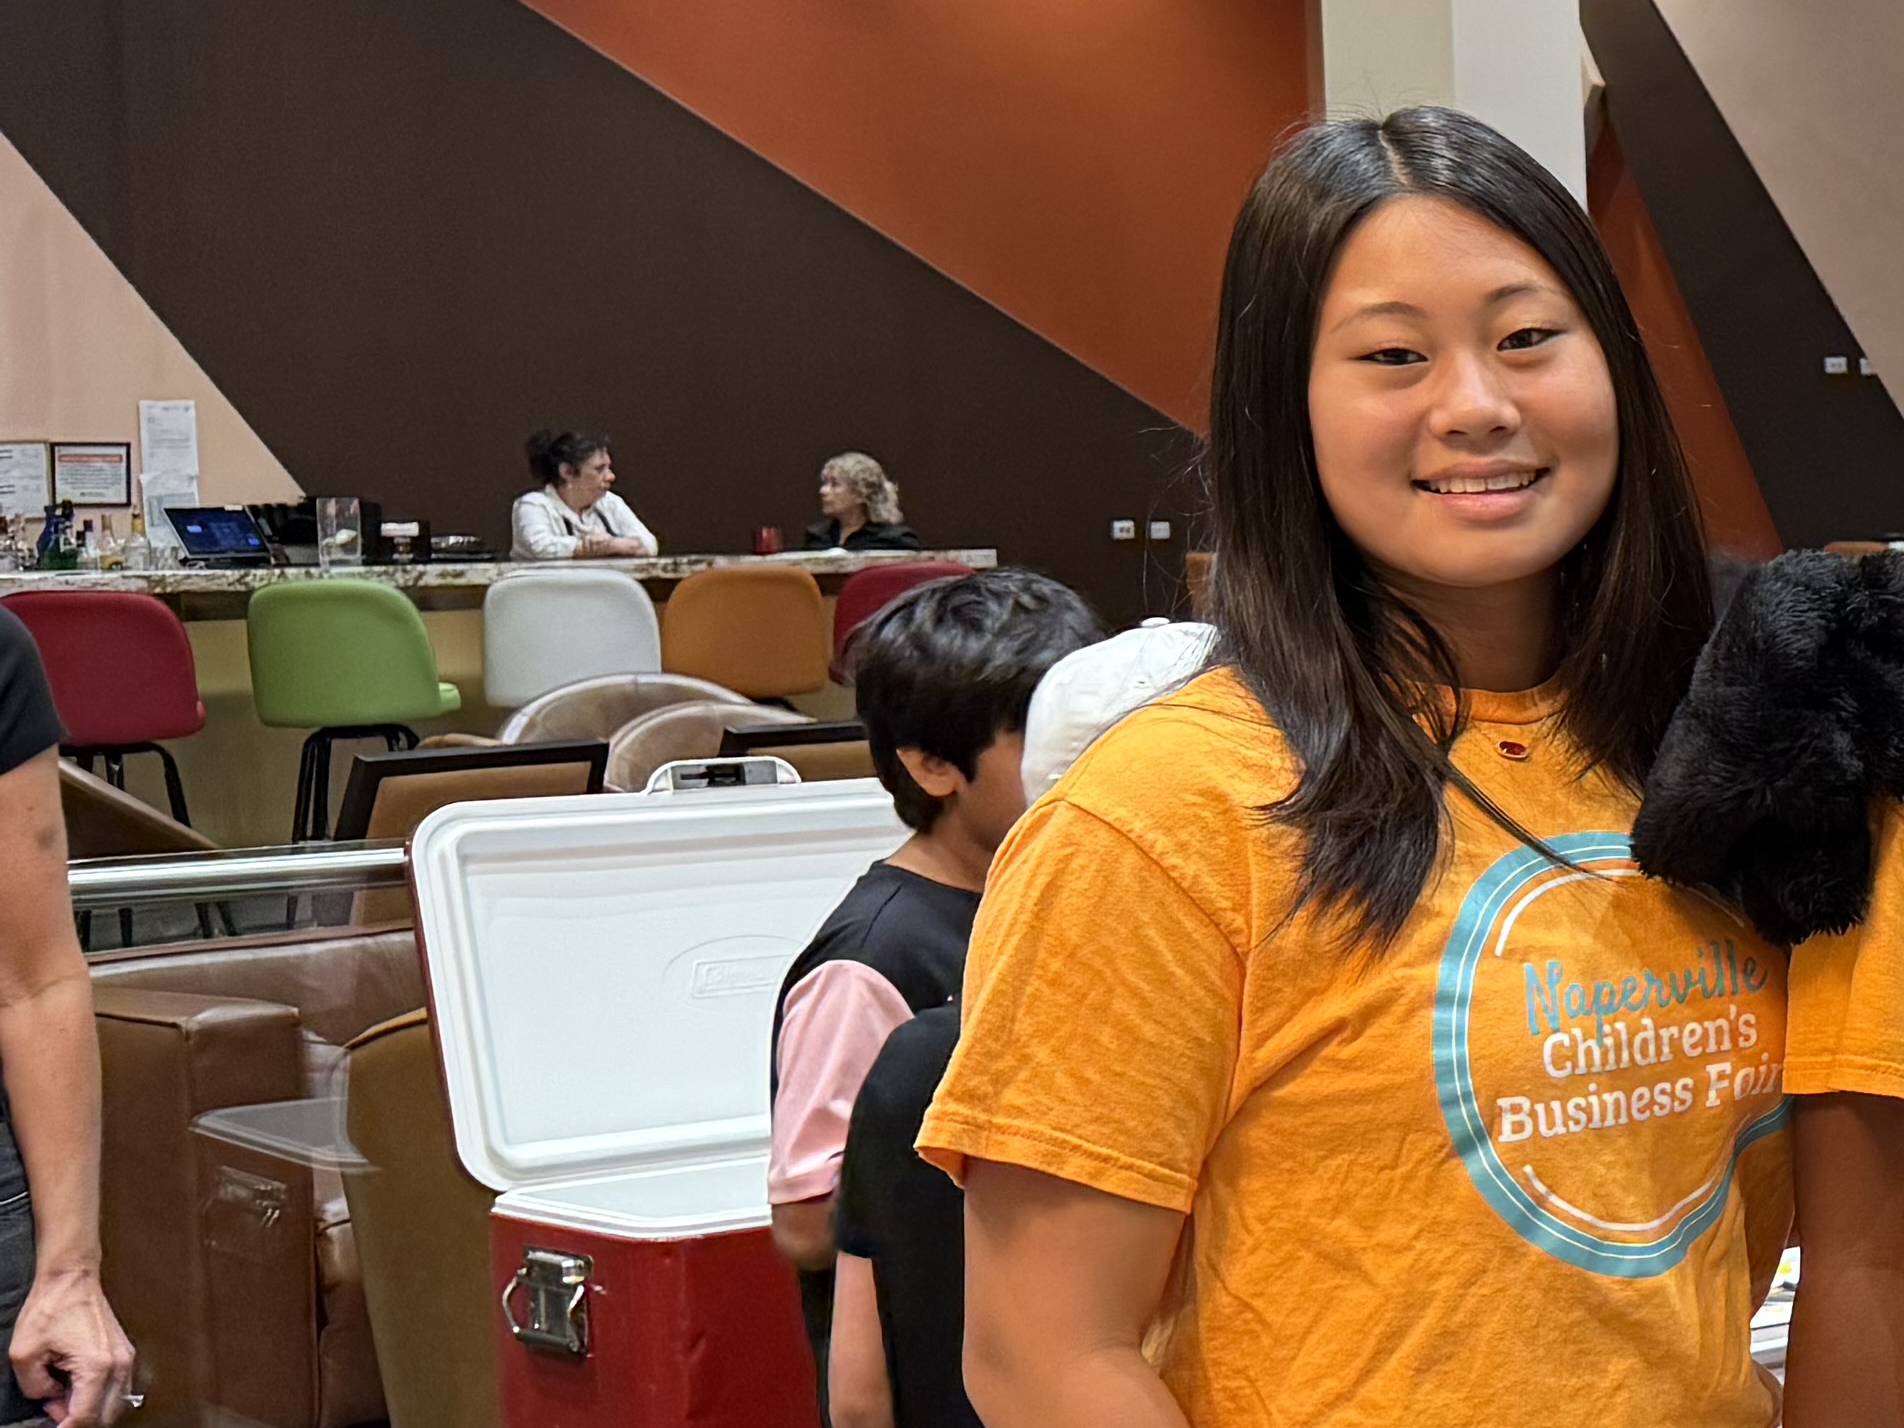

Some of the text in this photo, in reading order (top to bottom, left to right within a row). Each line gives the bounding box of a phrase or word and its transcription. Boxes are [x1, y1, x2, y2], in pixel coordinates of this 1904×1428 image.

[1523, 938, 1769, 1046] Naperville
[1542, 1004, 1758, 1079] Children's
[1496, 1052, 1783, 1143] Business Fair
